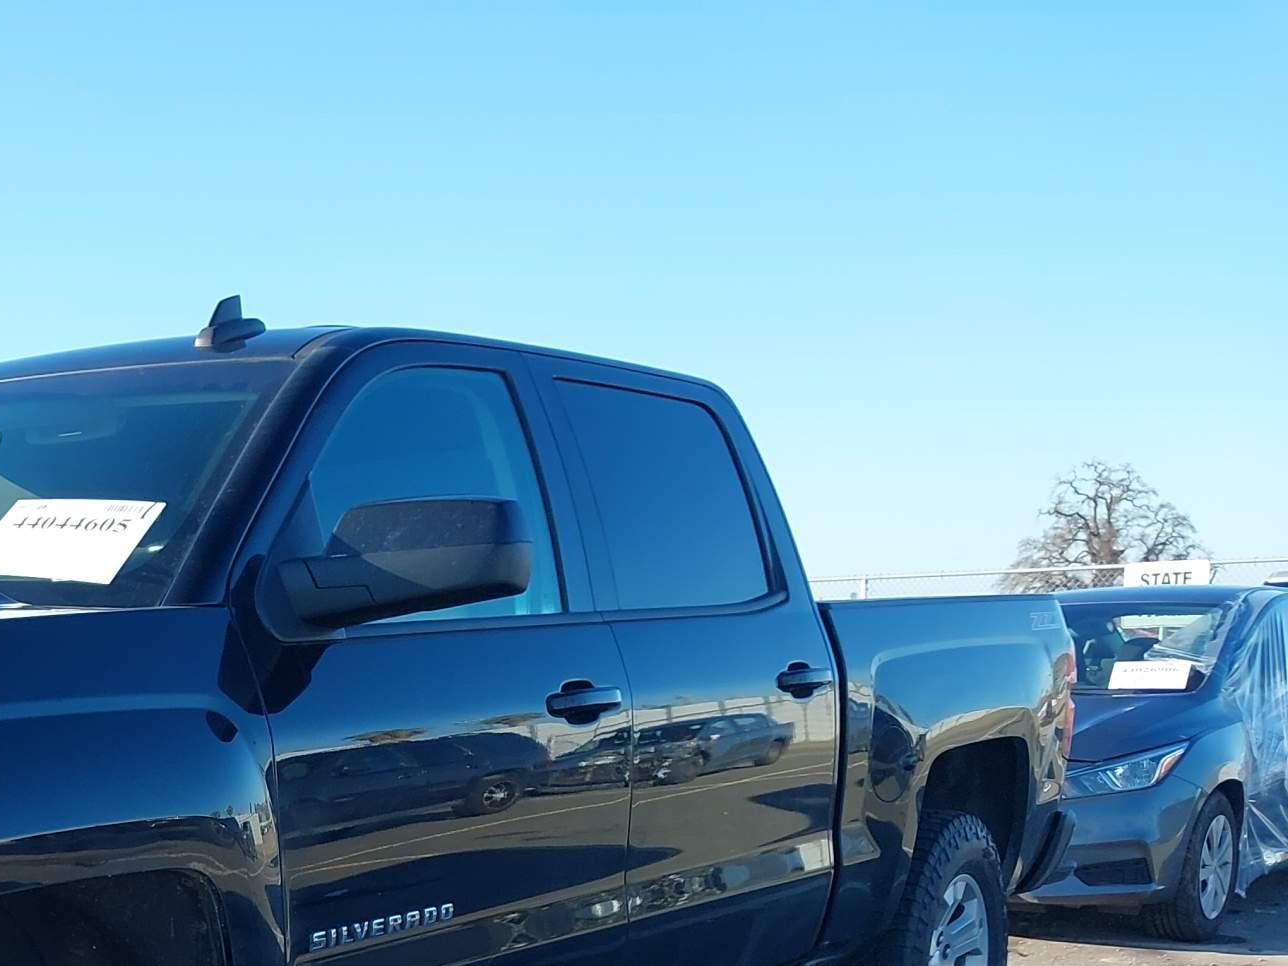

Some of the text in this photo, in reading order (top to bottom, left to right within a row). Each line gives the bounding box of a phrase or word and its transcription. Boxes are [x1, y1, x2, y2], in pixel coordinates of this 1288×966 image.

[13, 517, 132, 532] 44044605
[1140, 571, 1192, 585] STATE
[311, 902, 454, 950] SILVERADO
